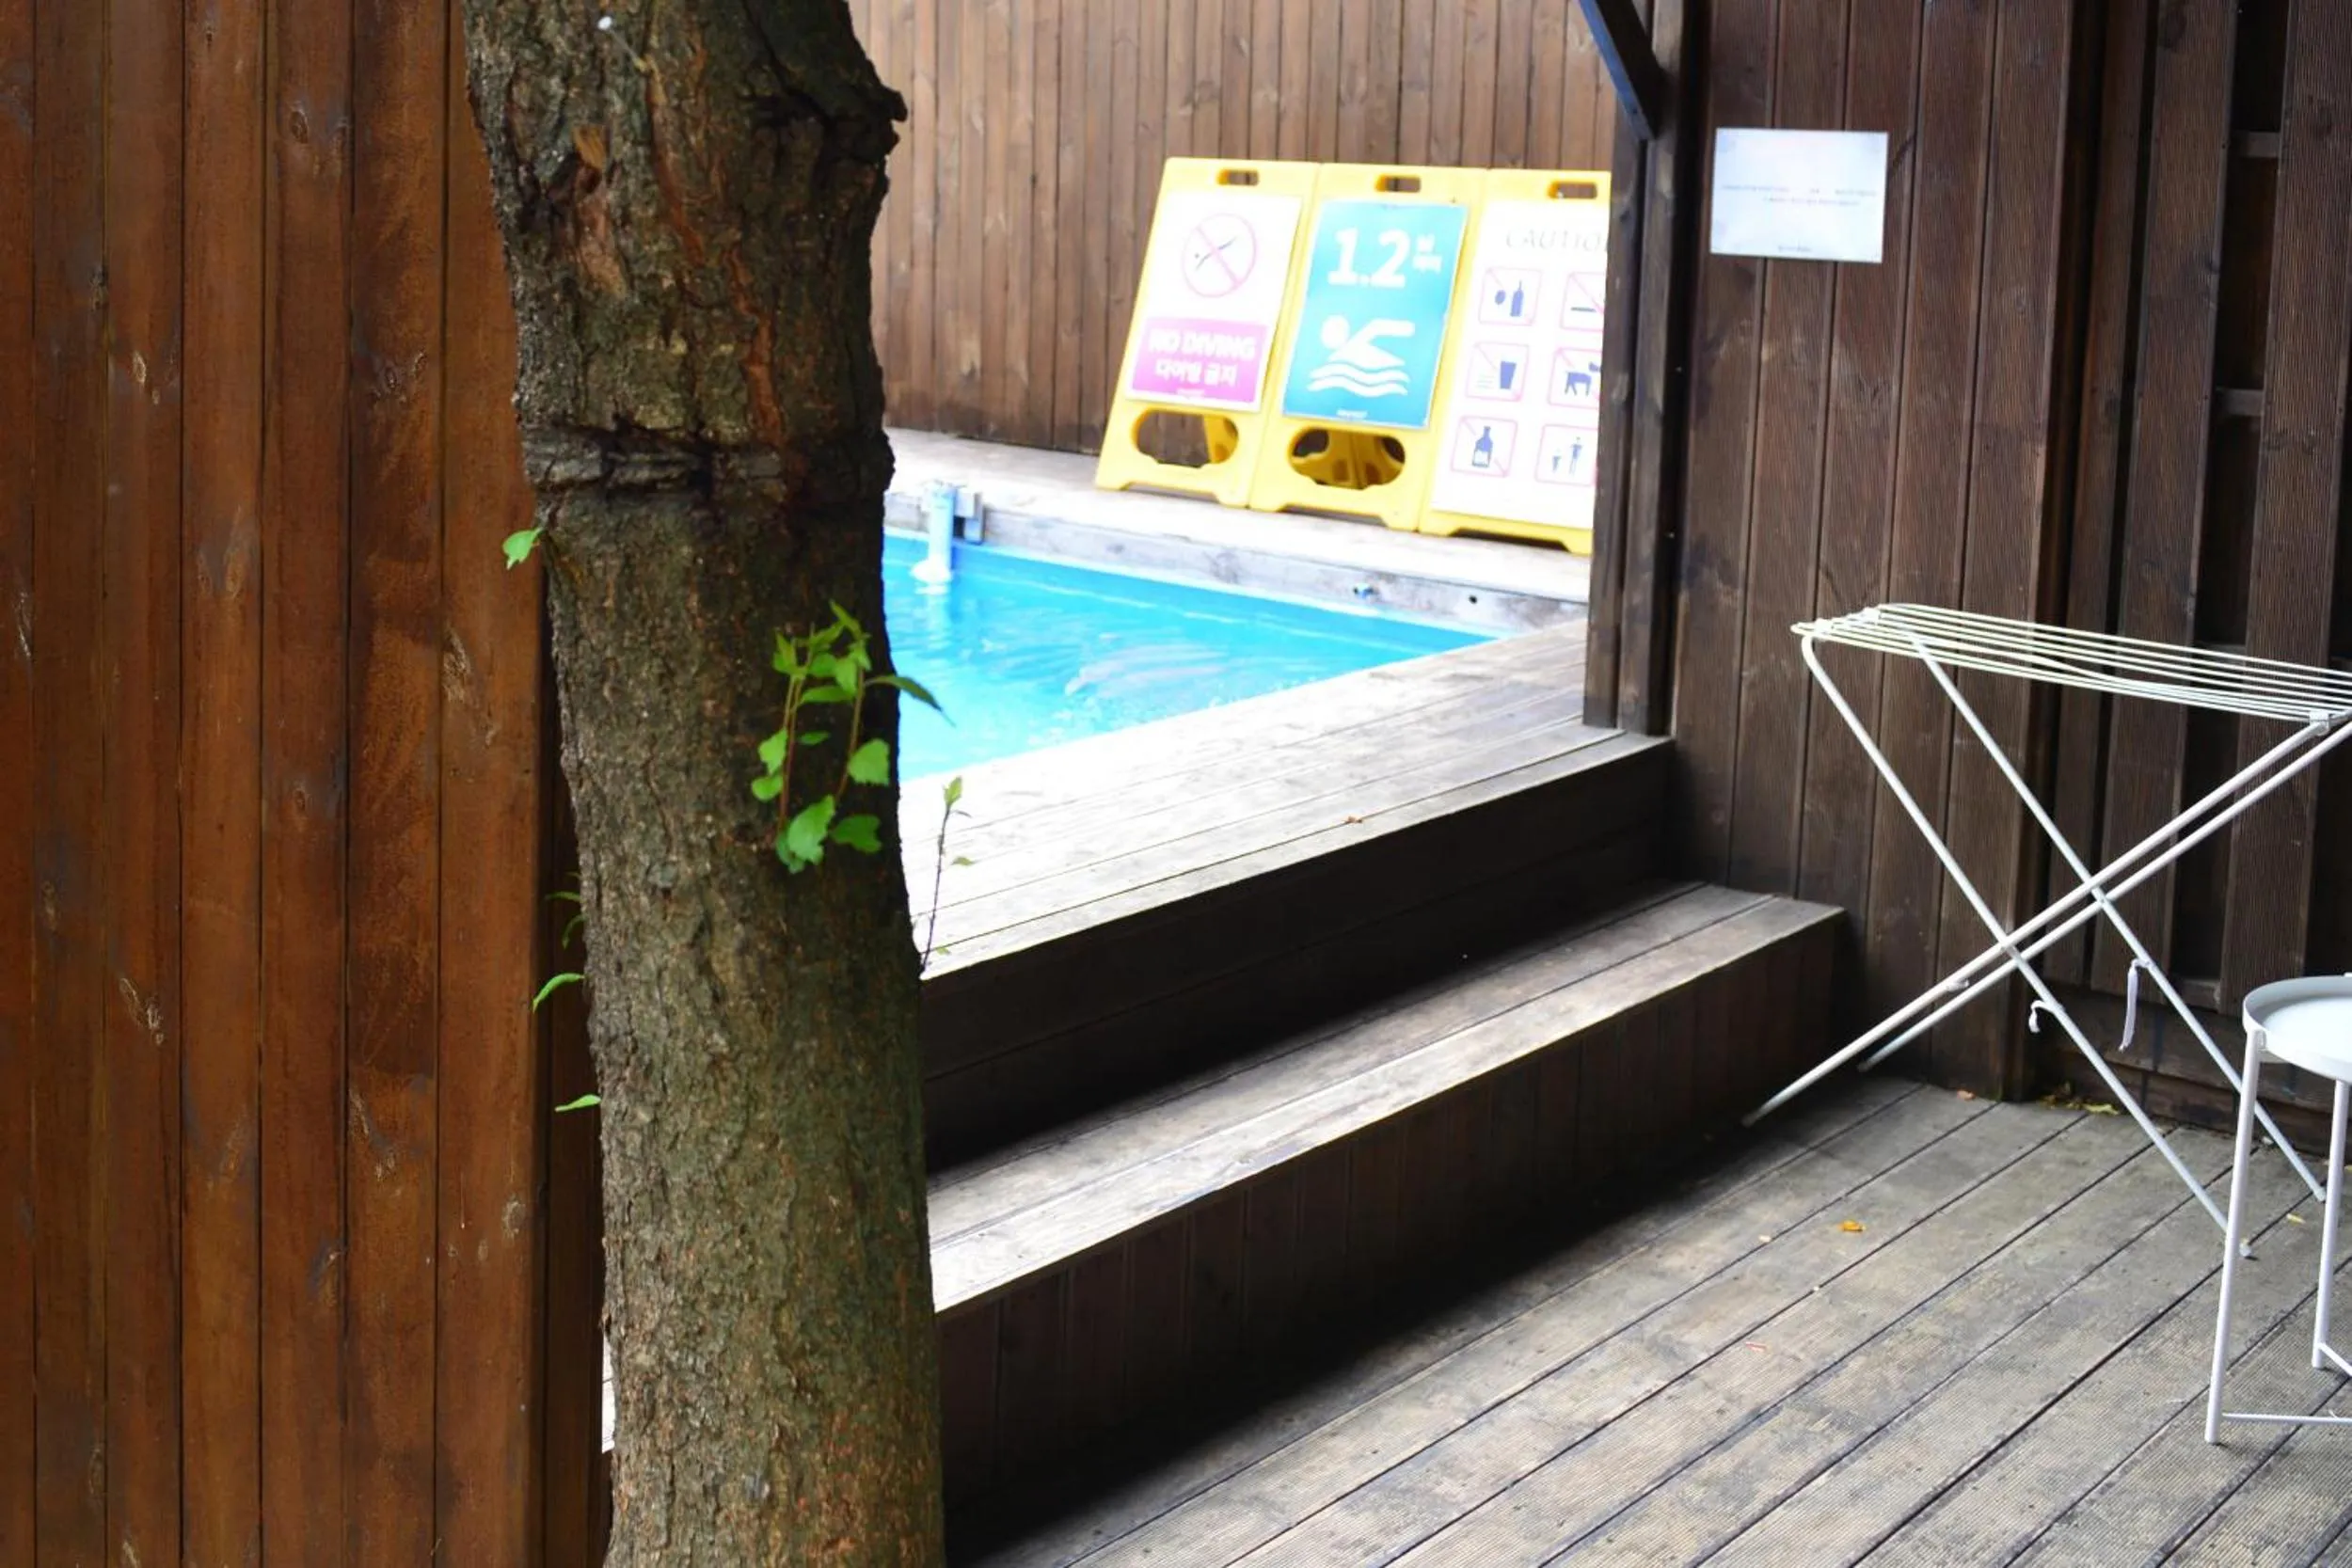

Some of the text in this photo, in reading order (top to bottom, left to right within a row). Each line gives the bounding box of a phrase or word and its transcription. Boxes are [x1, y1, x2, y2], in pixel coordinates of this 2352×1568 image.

[1505, 228, 1608, 253] CAUTIO
[1327, 227, 1410, 288] 1.2
[1149, 329, 1256, 360] NO DIVING
[1155, 358, 1202, 384] 다이빙
